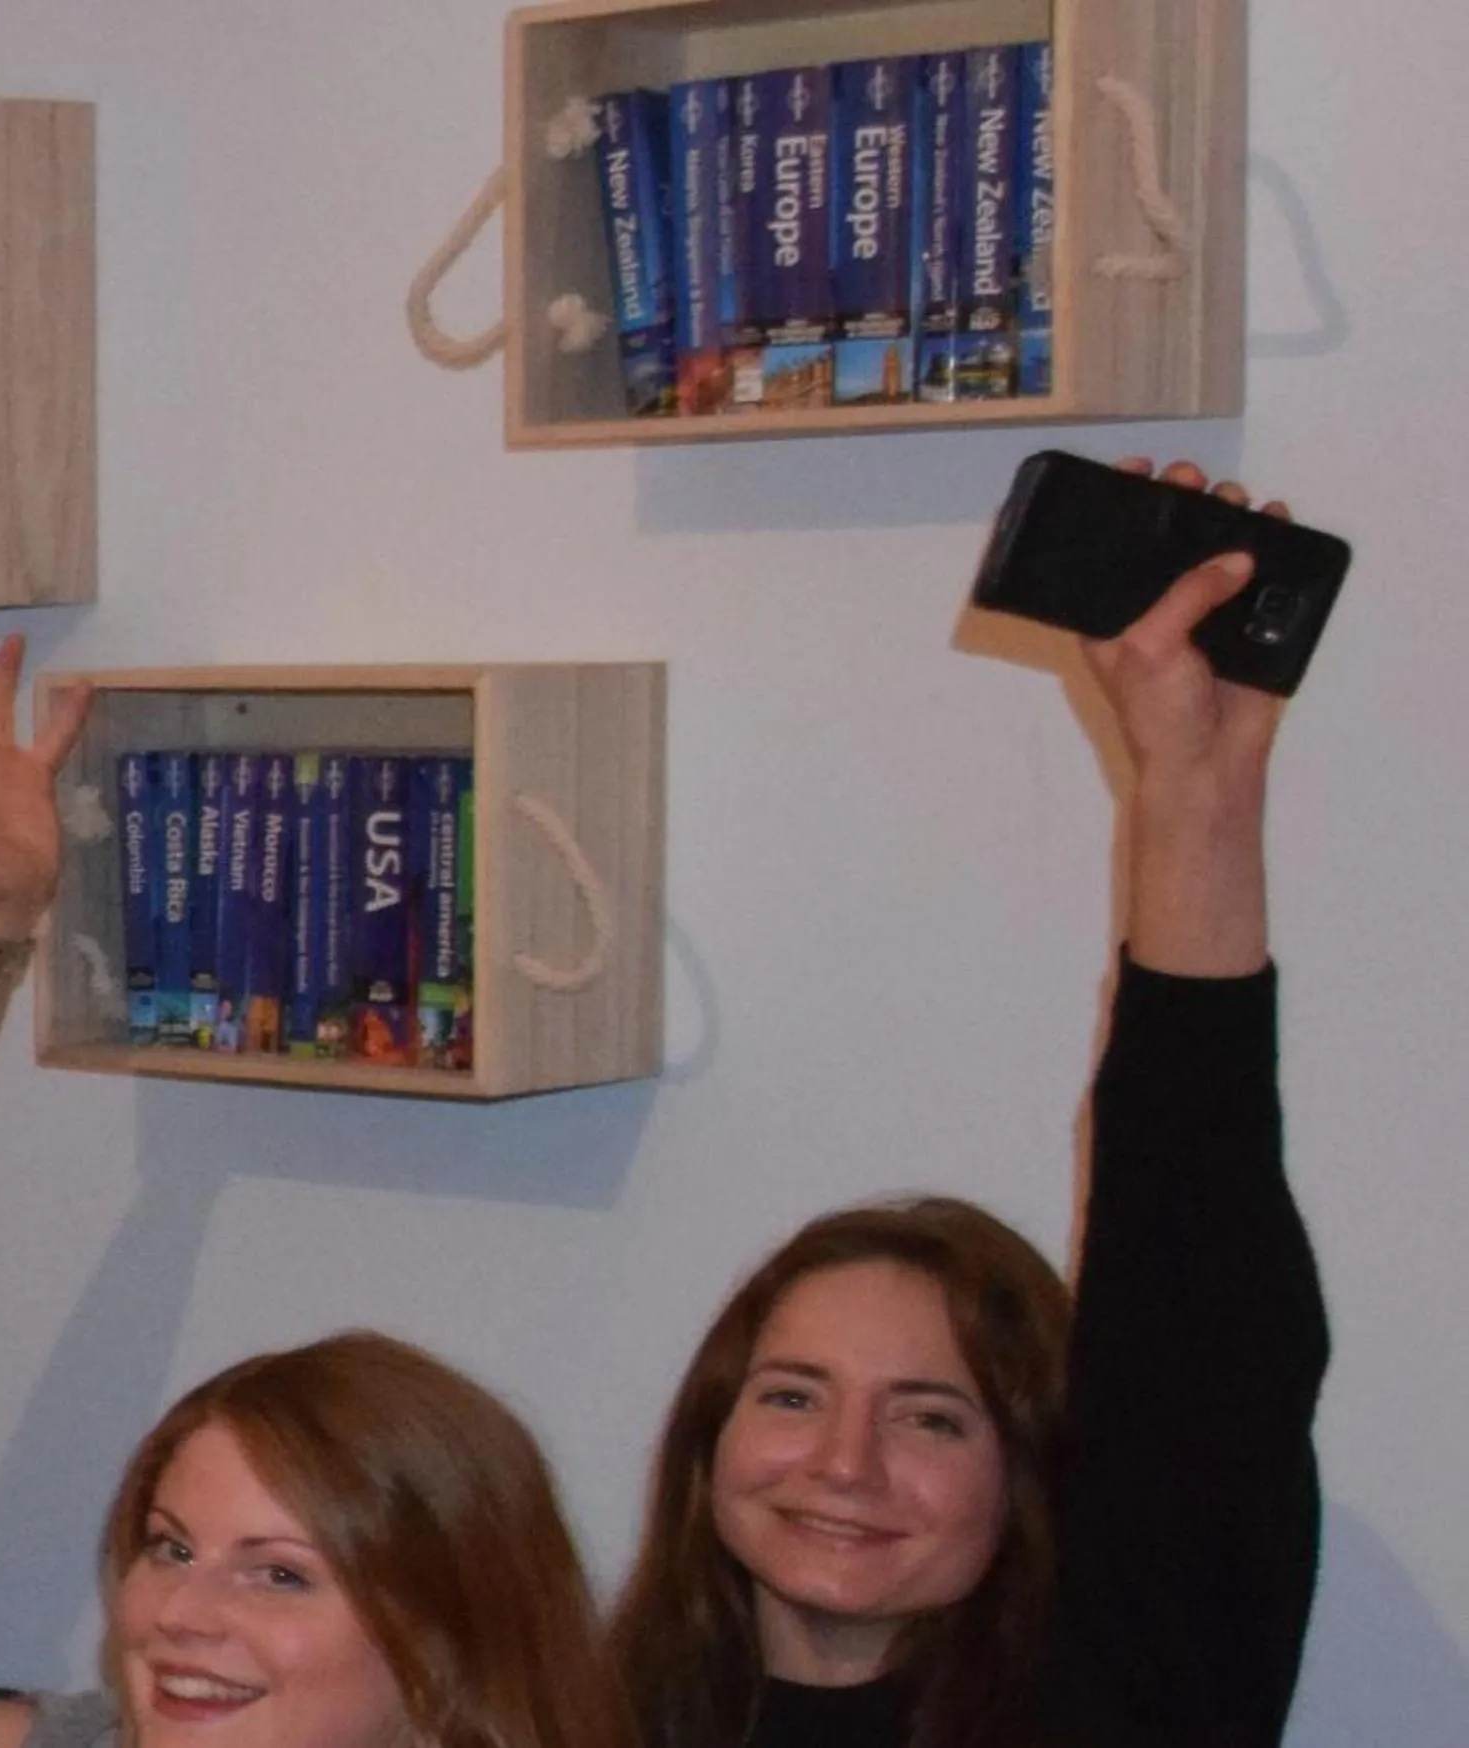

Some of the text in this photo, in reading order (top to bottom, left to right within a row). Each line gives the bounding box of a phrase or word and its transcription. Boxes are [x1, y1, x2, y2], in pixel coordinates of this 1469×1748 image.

[740, 134, 758, 192] Korea
[767, 135, 807, 267] Europe
[808, 133, 827, 209] Eastern
[845, 126, 886, 260] Europe
[886, 124, 905, 209] Western
[974, 107, 1006, 296] New Zealand
[605, 148, 645, 319] New Zealand
[1030, 188, 1053, 311] Zead
[125, 811, 145, 895] Colombia
[165, 812, 188, 923] Costa Rica
[198, 806, 219, 875] Alaska
[229, 810, 250, 891] Vietnam
[261, 813, 283, 902] Morocco
[364, 810, 402, 912] USA
[439, 812, 455, 888] central
[437, 892, 453, 978] america
